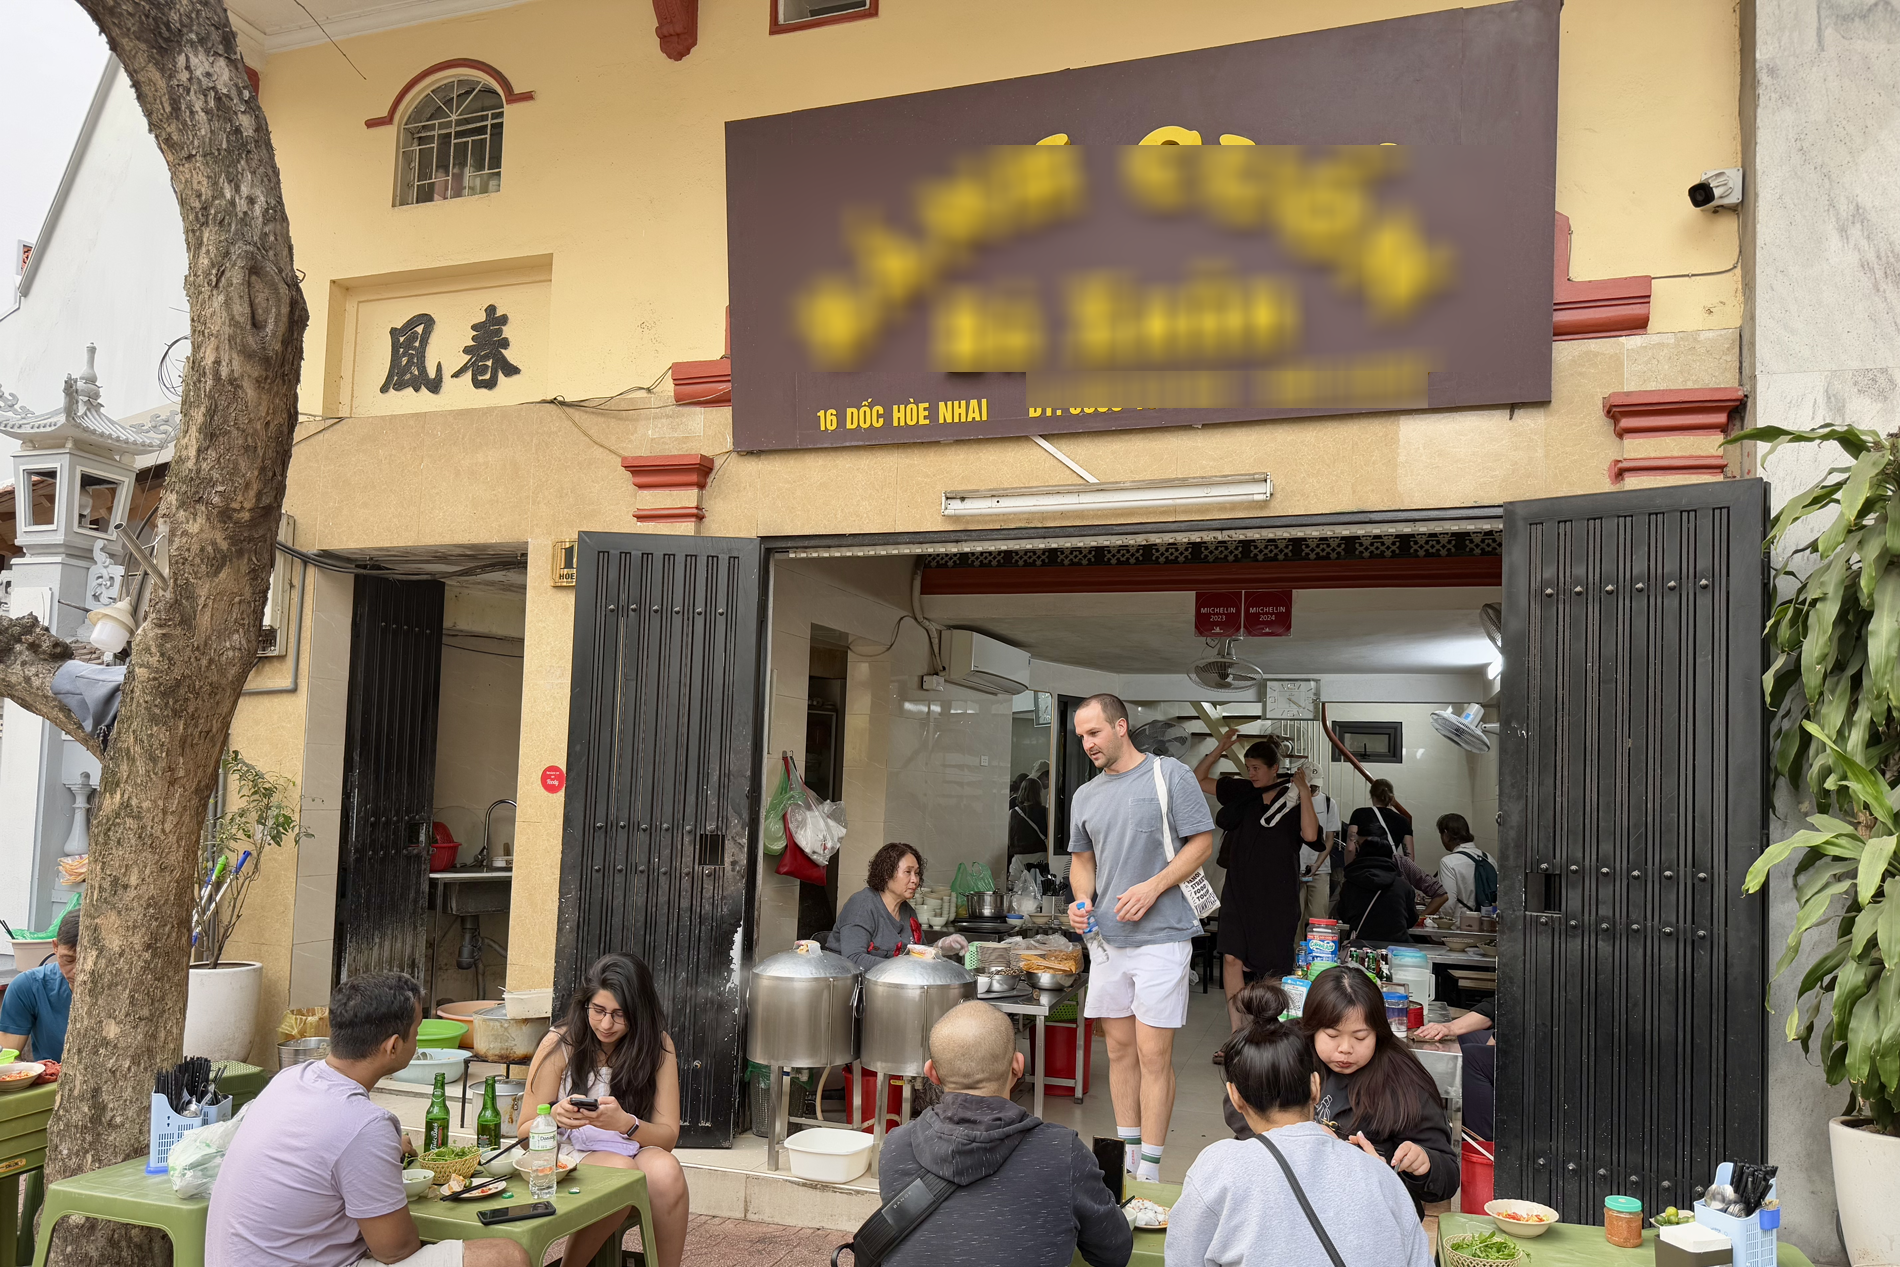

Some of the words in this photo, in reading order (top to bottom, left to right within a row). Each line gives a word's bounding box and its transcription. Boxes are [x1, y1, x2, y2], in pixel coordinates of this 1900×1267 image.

[816, 408, 838, 431] 16
[846, 397, 885, 430] DỐC
[892, 397, 930, 427] HÒE
[938, 398, 988, 424] NHAI
